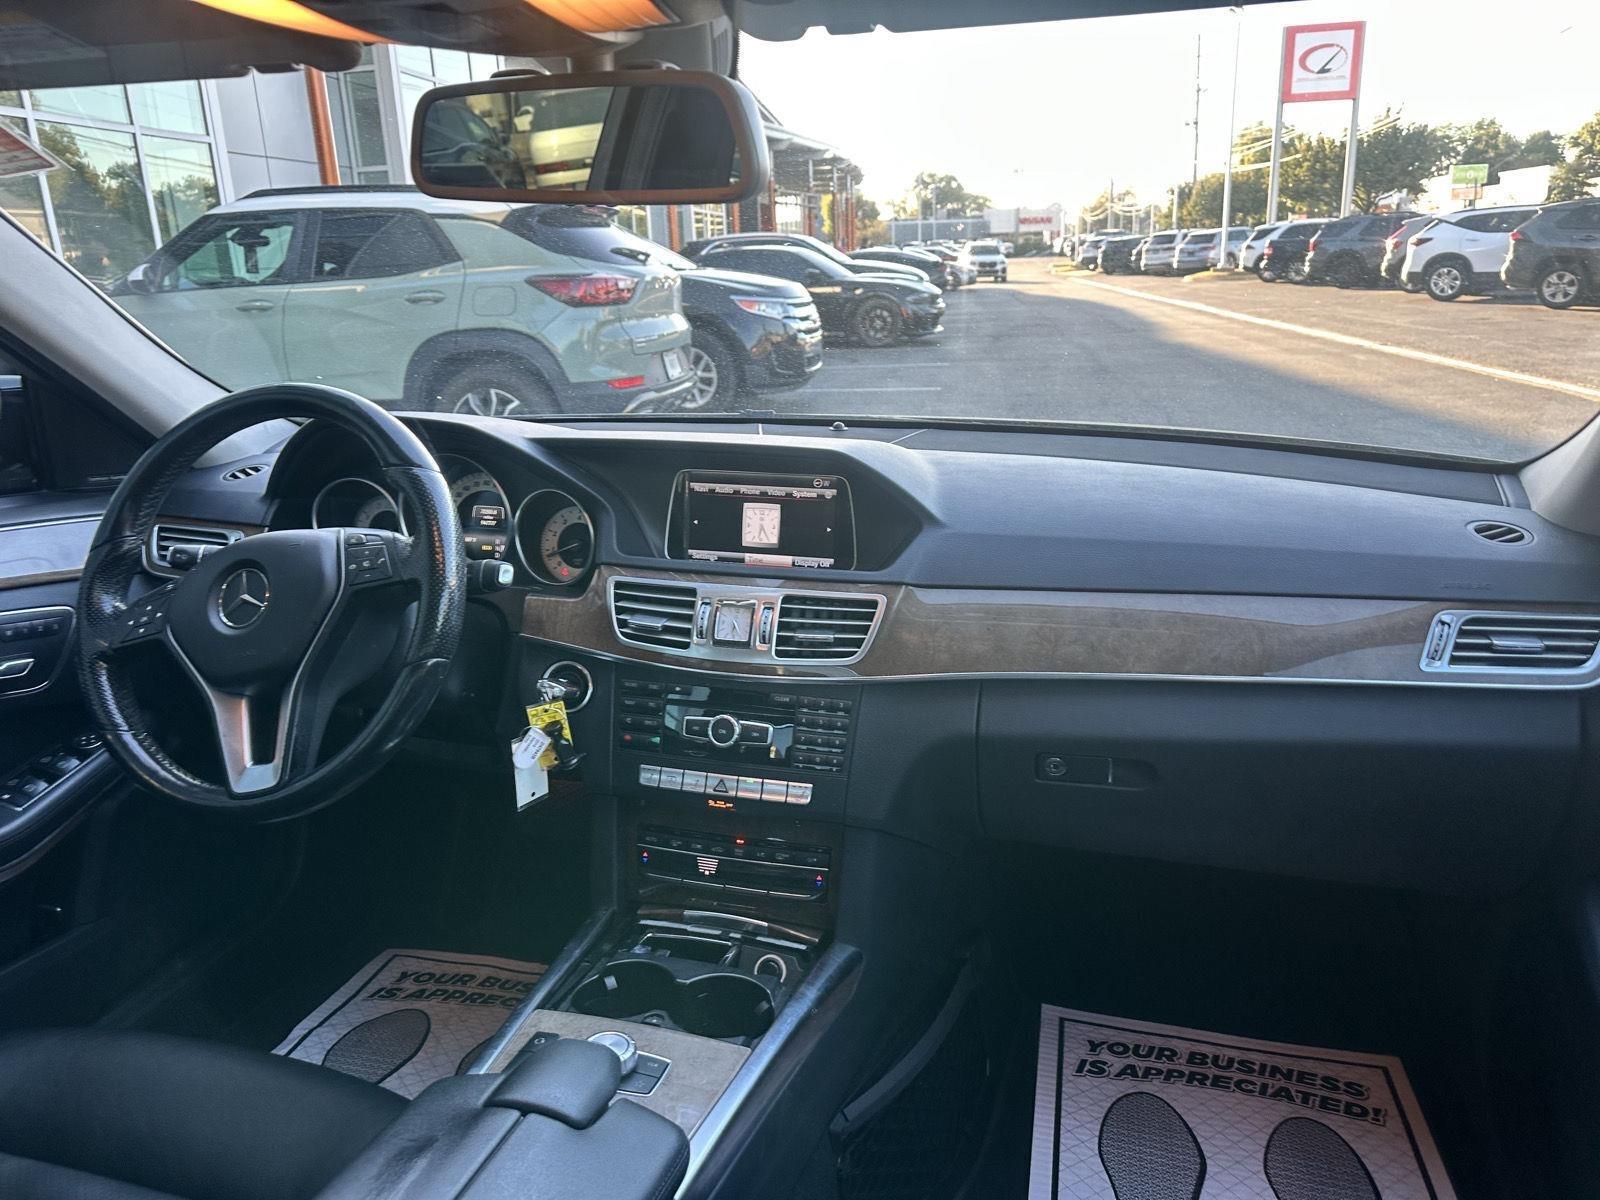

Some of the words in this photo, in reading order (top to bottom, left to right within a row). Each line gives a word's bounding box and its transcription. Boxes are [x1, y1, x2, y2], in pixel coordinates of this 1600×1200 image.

[1018, 216, 1053, 225] NISSAN
[715, 486, 734, 494] Audio
[740, 487, 761, 495] Phone
[767, 488, 786, 496] Video
[792, 489, 818, 499] System
[691, 551, 719, 562] Settings
[794, 558, 819, 568] Display
[393, 970, 480, 987] YOUR
[479, 975, 534, 993] BUS
[367, 986, 403, 1000] IS
[402, 988, 521, 1008] APPREC
[1085, 1038, 1179, 1064] YOUR
[1184, 1049, 1371, 1100] BUSINESS
[1072, 1058, 1111, 1078] IS
[1115, 1062, 1387, 1127] APPRECIATED!
